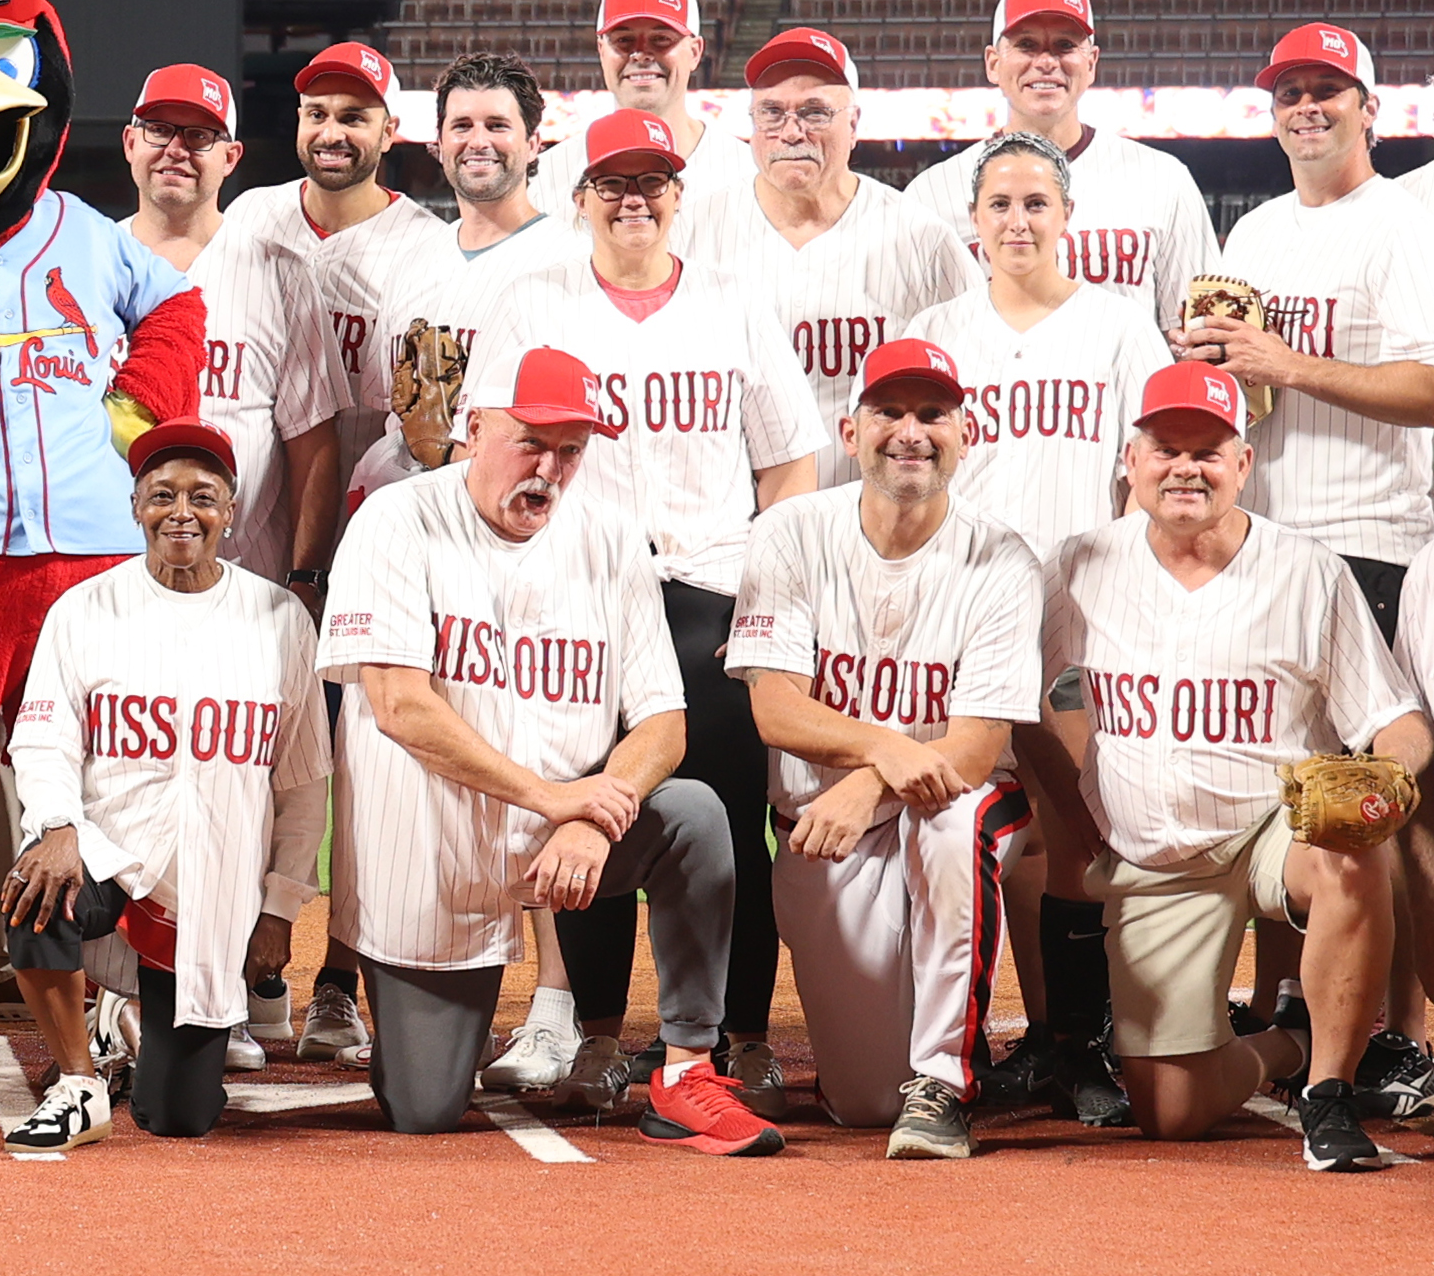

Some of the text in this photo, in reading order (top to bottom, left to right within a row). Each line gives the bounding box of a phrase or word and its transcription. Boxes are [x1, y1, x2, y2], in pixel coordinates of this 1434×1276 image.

[10, 336, 93, 396] Louis
[329, 612, 374, 628] GREATER
[736, 614, 774, 629] GREATER
[431, 612, 606, 705] MISSOURI
